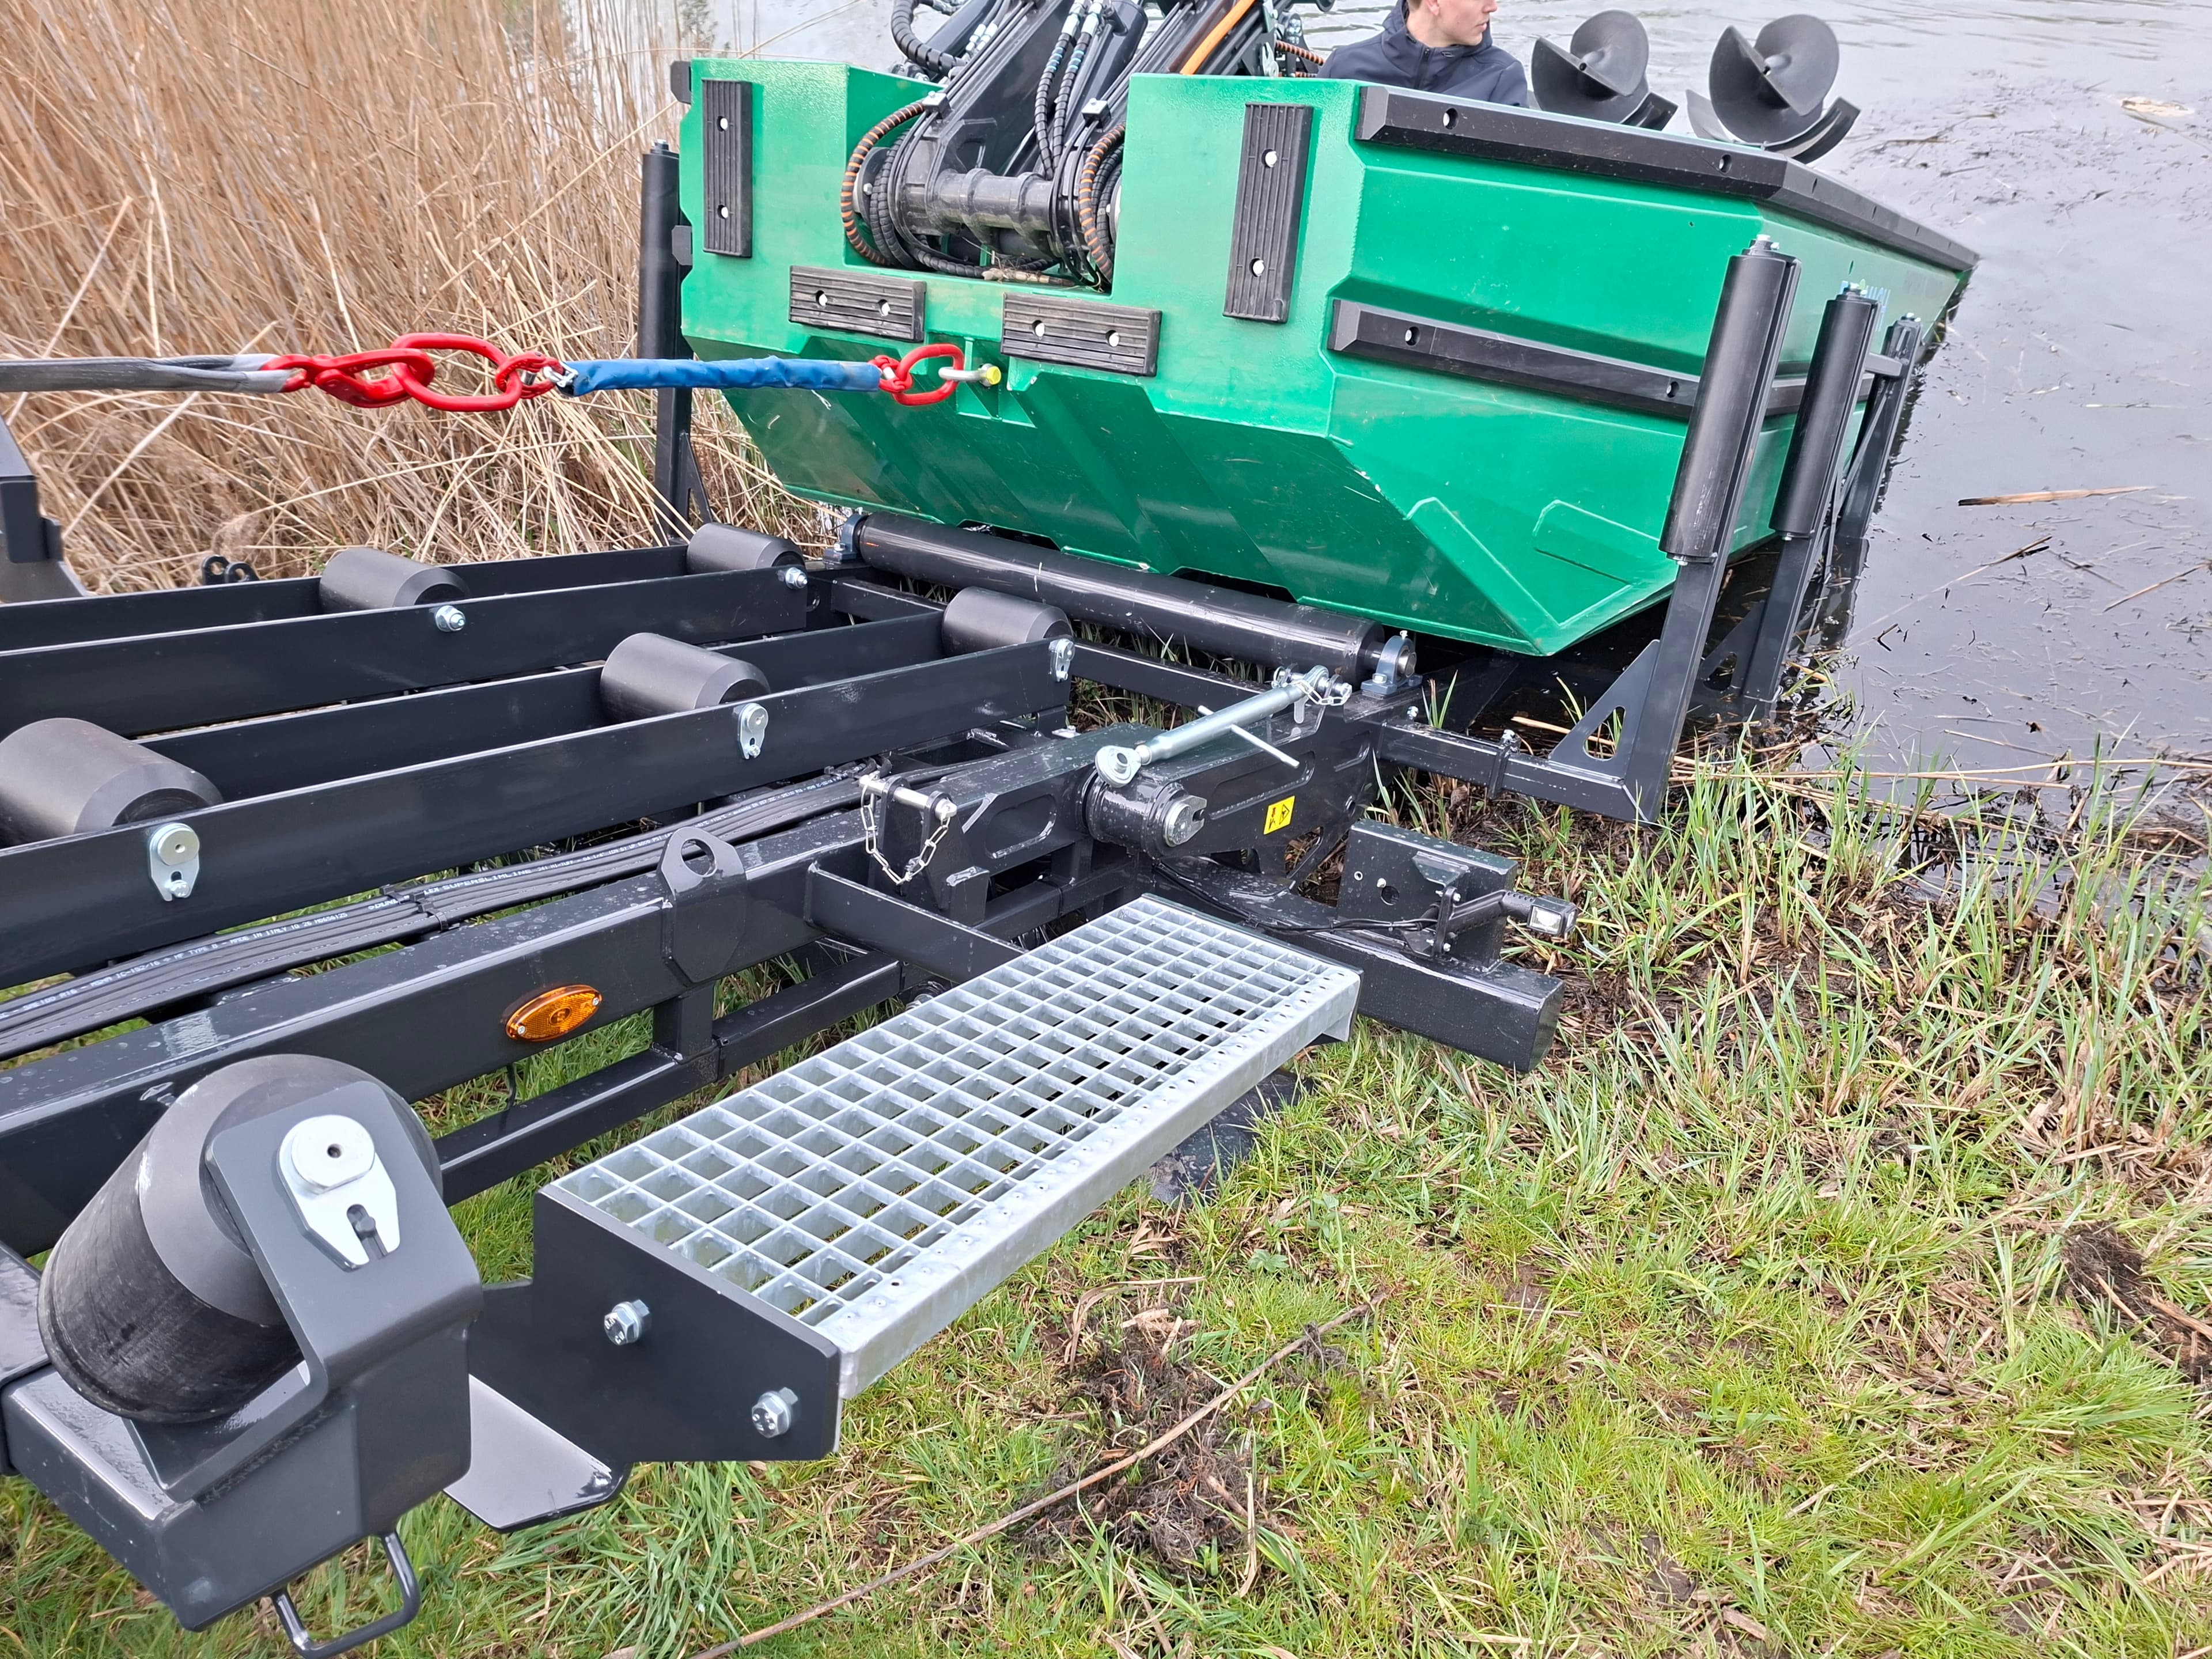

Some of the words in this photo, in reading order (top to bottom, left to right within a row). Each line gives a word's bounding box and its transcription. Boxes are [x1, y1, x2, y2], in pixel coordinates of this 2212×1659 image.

[442, 870, 532, 891] SUPERSLIMLINE
[59, 988, 77, 998] R16
[190, 945, 209, 955] TYPE
[230, 935, 249, 945] MADE
[266, 926, 287, 935] ITALY
